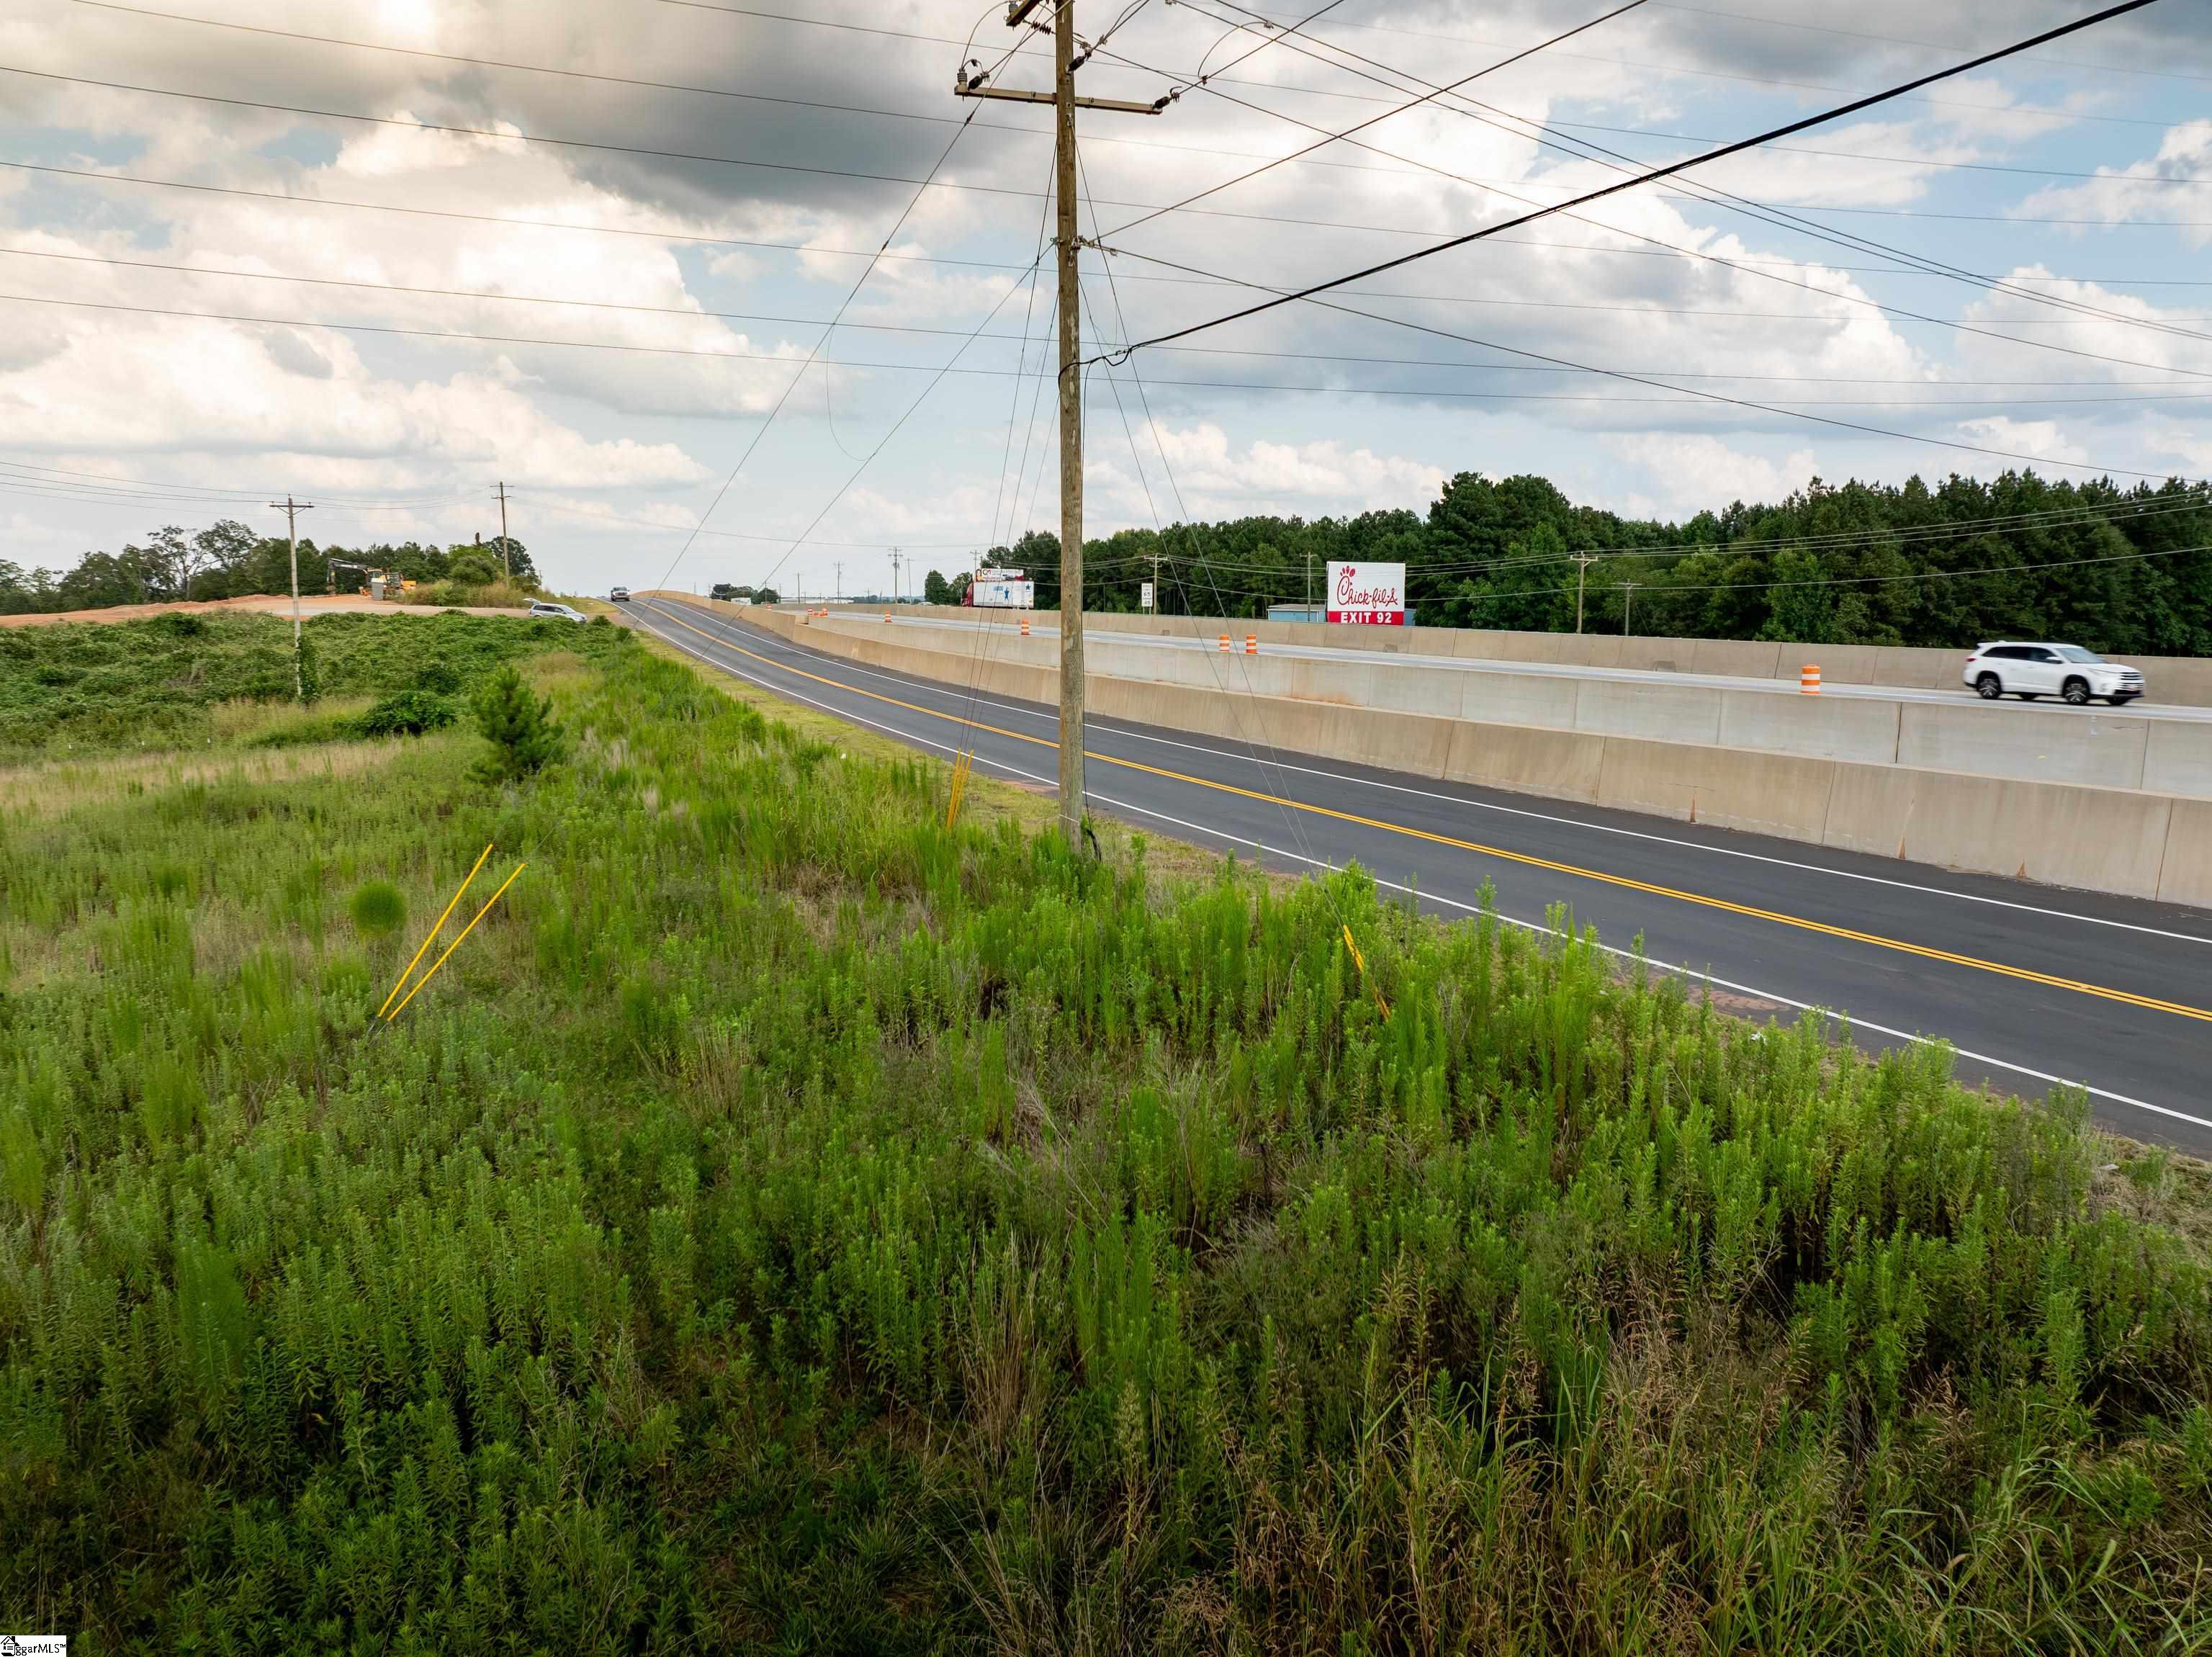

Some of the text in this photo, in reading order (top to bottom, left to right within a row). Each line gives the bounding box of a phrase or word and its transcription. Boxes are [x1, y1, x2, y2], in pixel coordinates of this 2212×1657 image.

[1337, 574, 1398, 609] Chick-fil-A
[1341, 612, 1392, 624] EXIT 92
